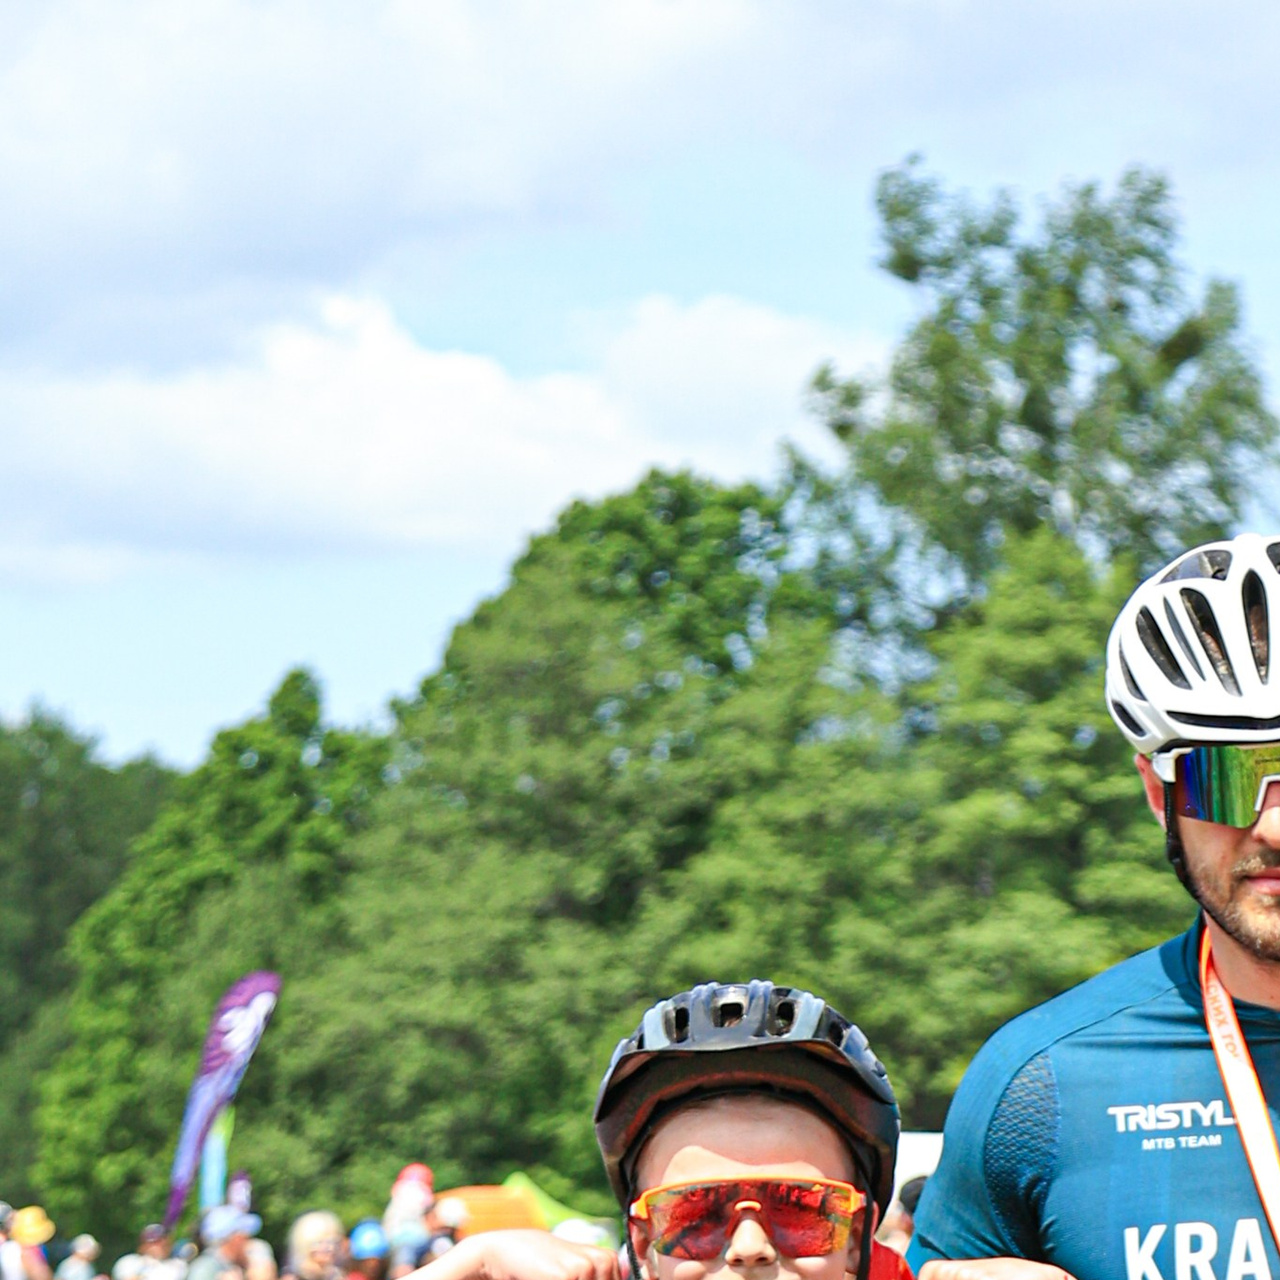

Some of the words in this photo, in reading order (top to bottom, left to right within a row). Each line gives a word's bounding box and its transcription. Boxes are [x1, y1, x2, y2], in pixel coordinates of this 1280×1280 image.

[1107, 1099, 1239, 1133] TRISTYL
[1142, 1135, 1175, 1151] MTB
[1178, 1133, 1223, 1149] TEAM
